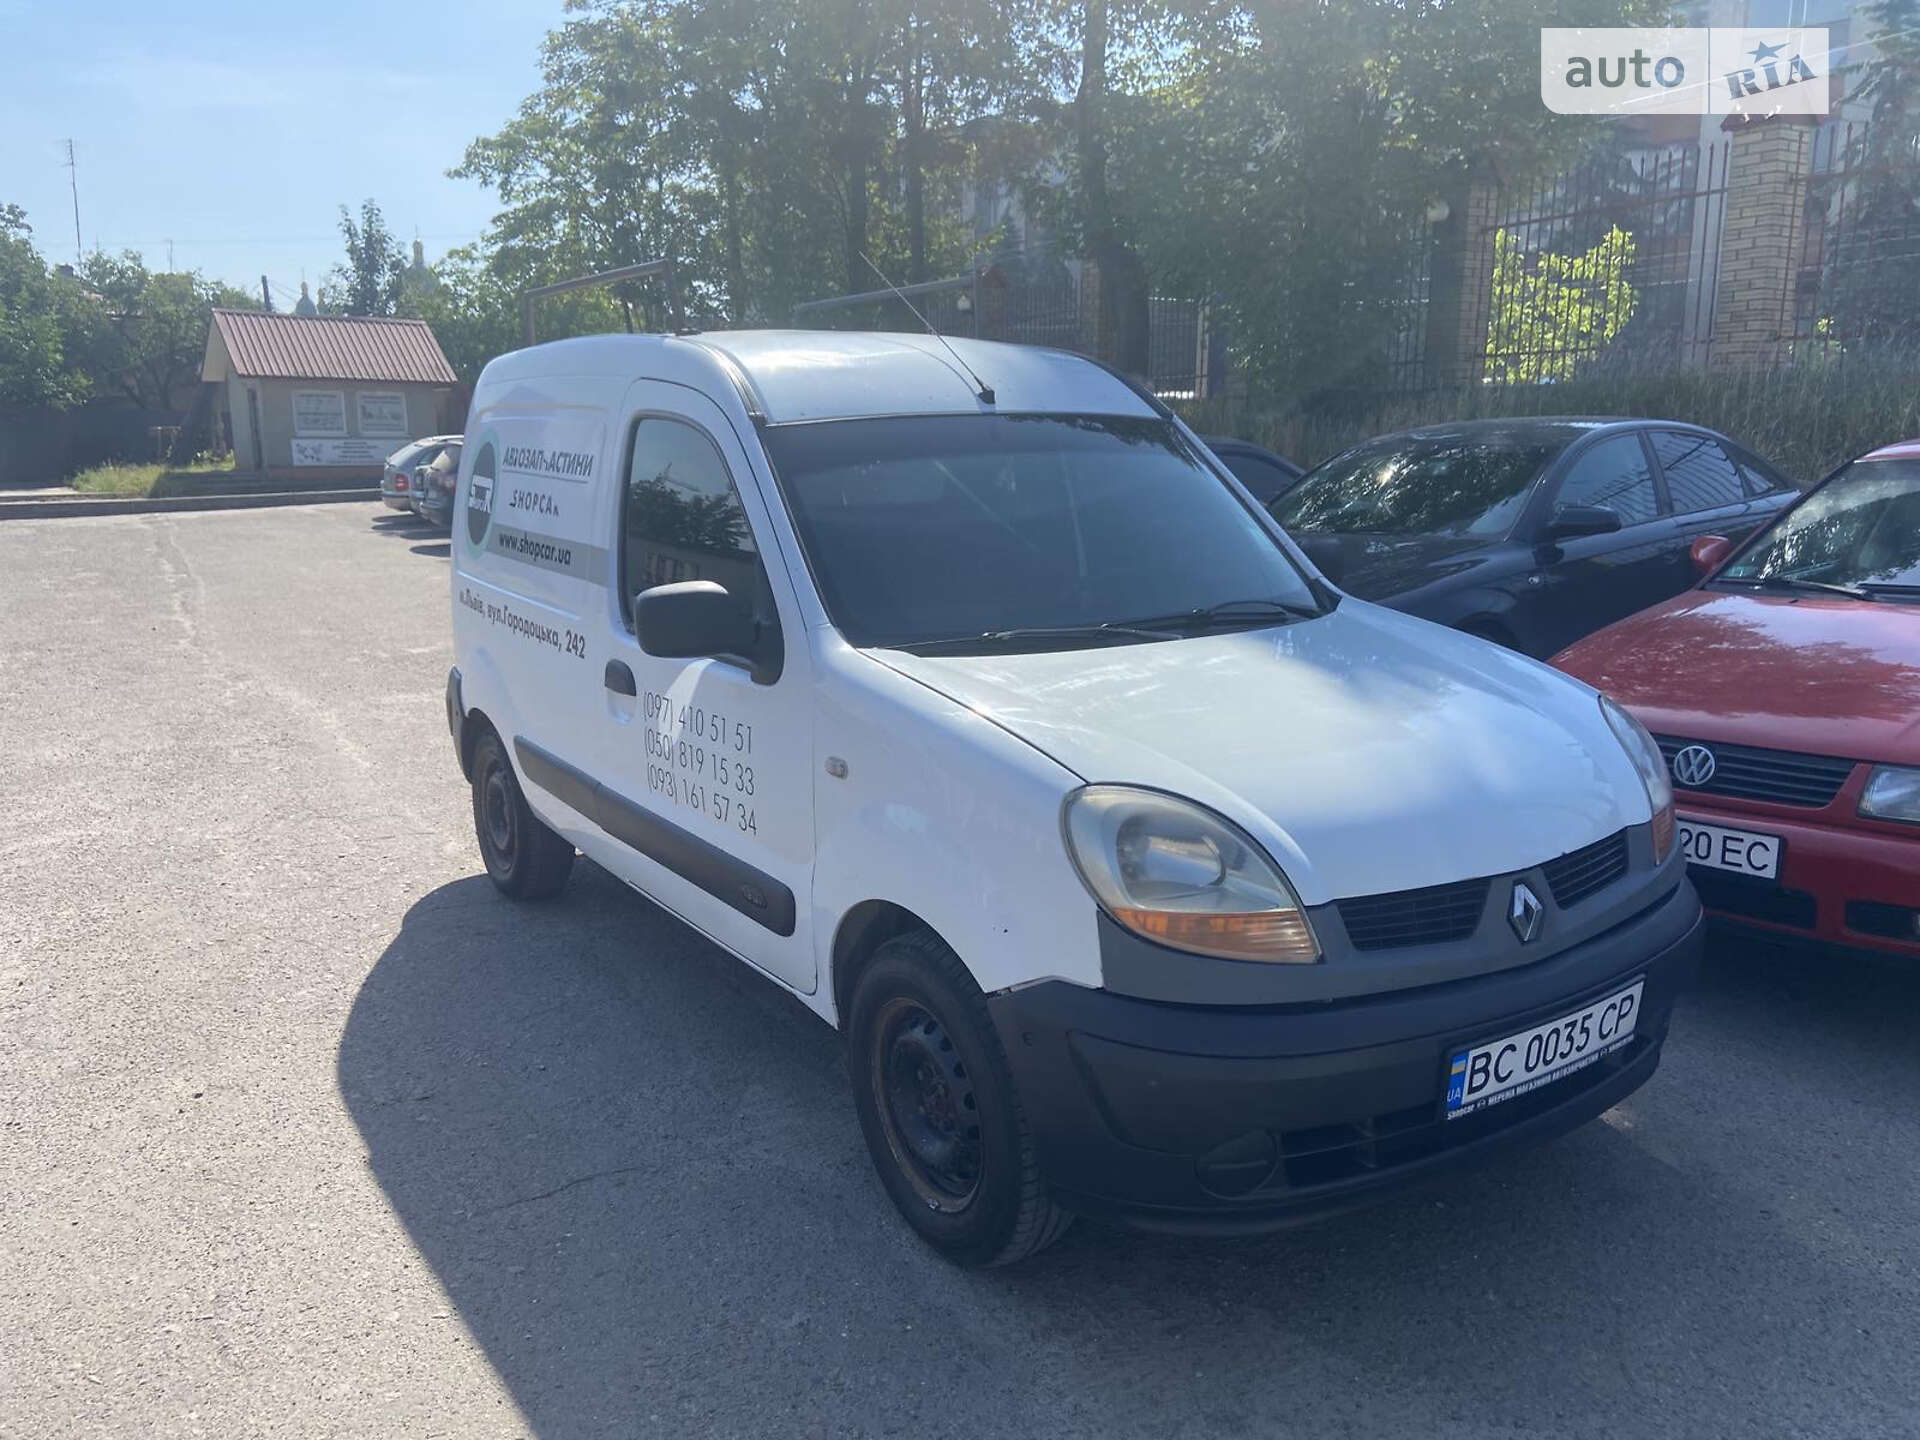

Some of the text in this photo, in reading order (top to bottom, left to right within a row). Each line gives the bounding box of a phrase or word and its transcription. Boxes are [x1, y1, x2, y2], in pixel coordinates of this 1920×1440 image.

[499, 531, 571, 566] www.shopcar.ua
[566, 629, 585, 659] 242
[643, 691, 751, 754] (097) 410 51 51
[644, 727, 755, 796] (050) 819 15 33
[647, 762, 757, 836] (093) 161 57 34
[1720, 835, 1770, 872] EC
[1467, 1043, 1517, 1095] BC
[1524, 1012, 1593, 1073] 0035
[1598, 994, 1635, 1040] CP
[1447, 1087, 1461, 1102] UA
